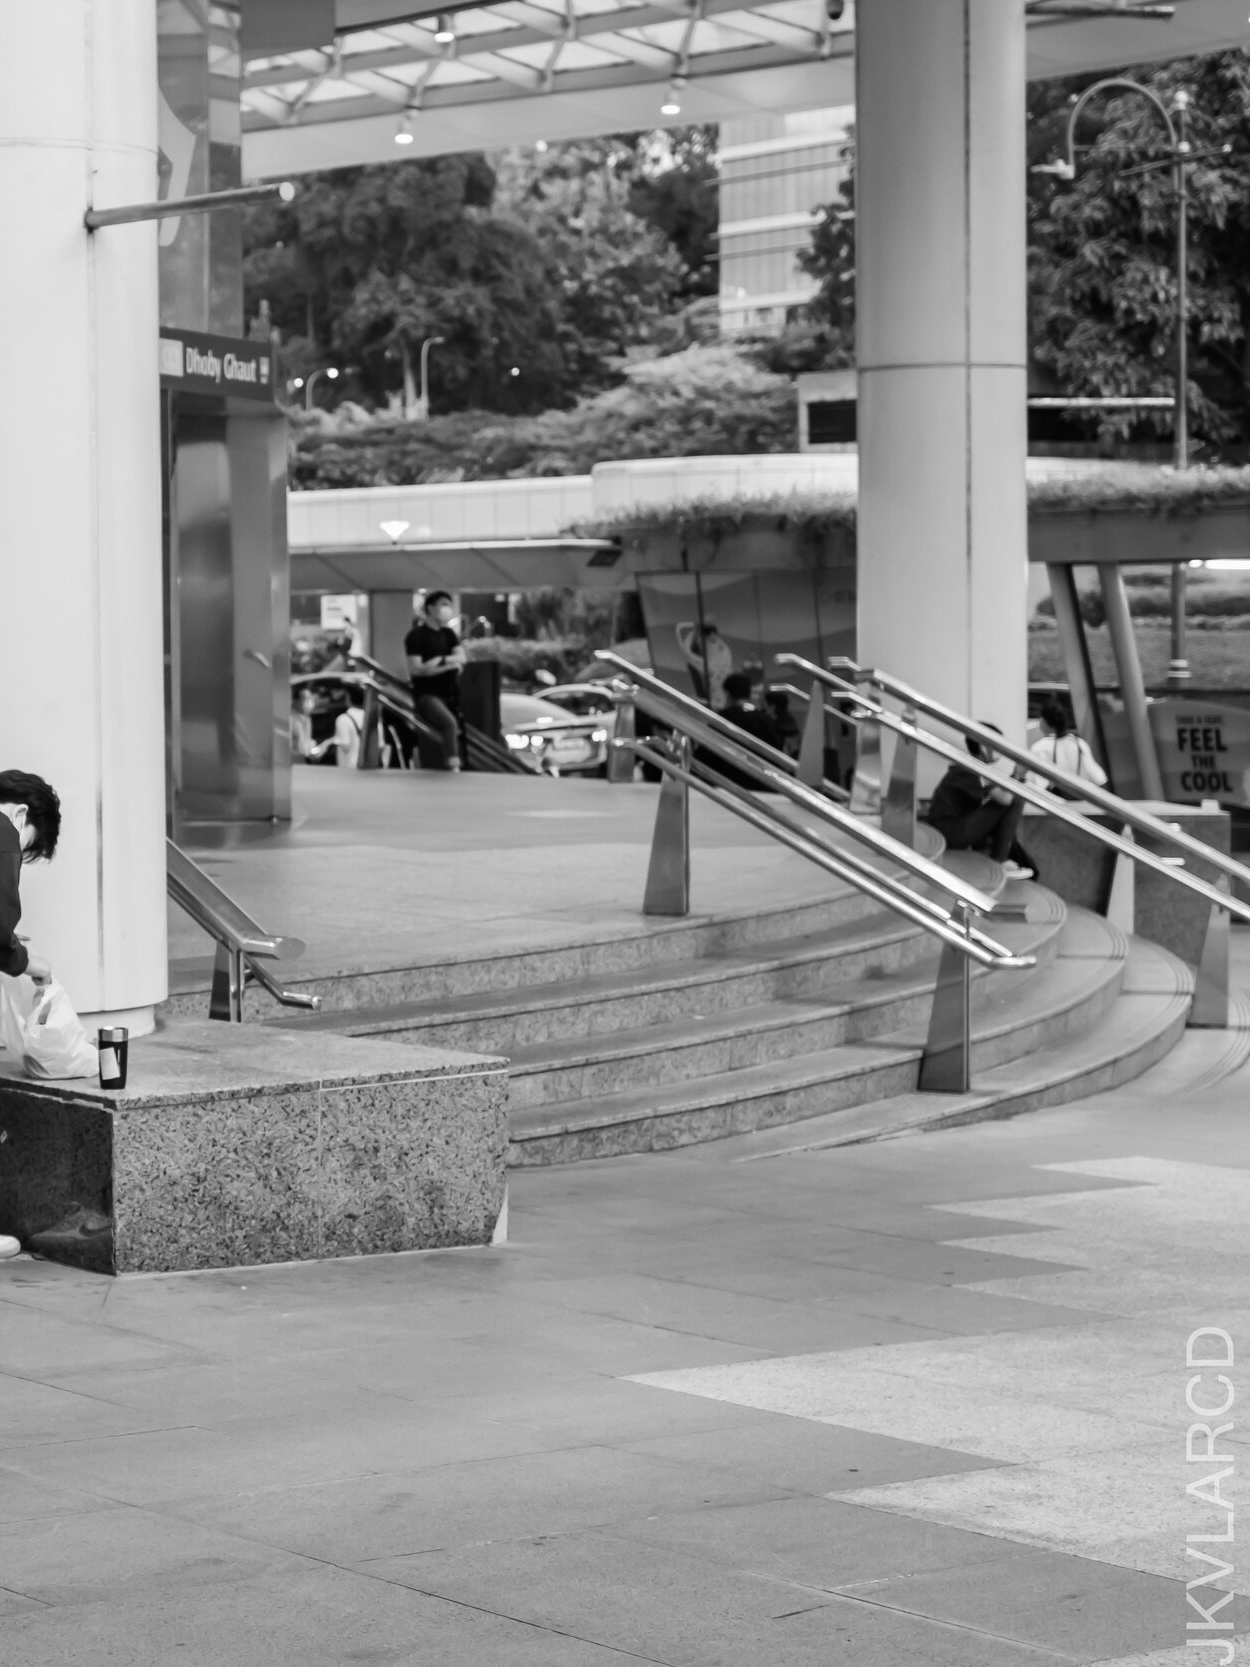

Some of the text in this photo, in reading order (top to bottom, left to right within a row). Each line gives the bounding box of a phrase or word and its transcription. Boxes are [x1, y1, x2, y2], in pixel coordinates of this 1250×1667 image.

[185, 347, 257, 383] Dhoby Ghaut
[1177, 728, 1228, 752] FEEL
[1191, 755, 1216, 769] THE
[1181, 771, 1233, 792] COOL
